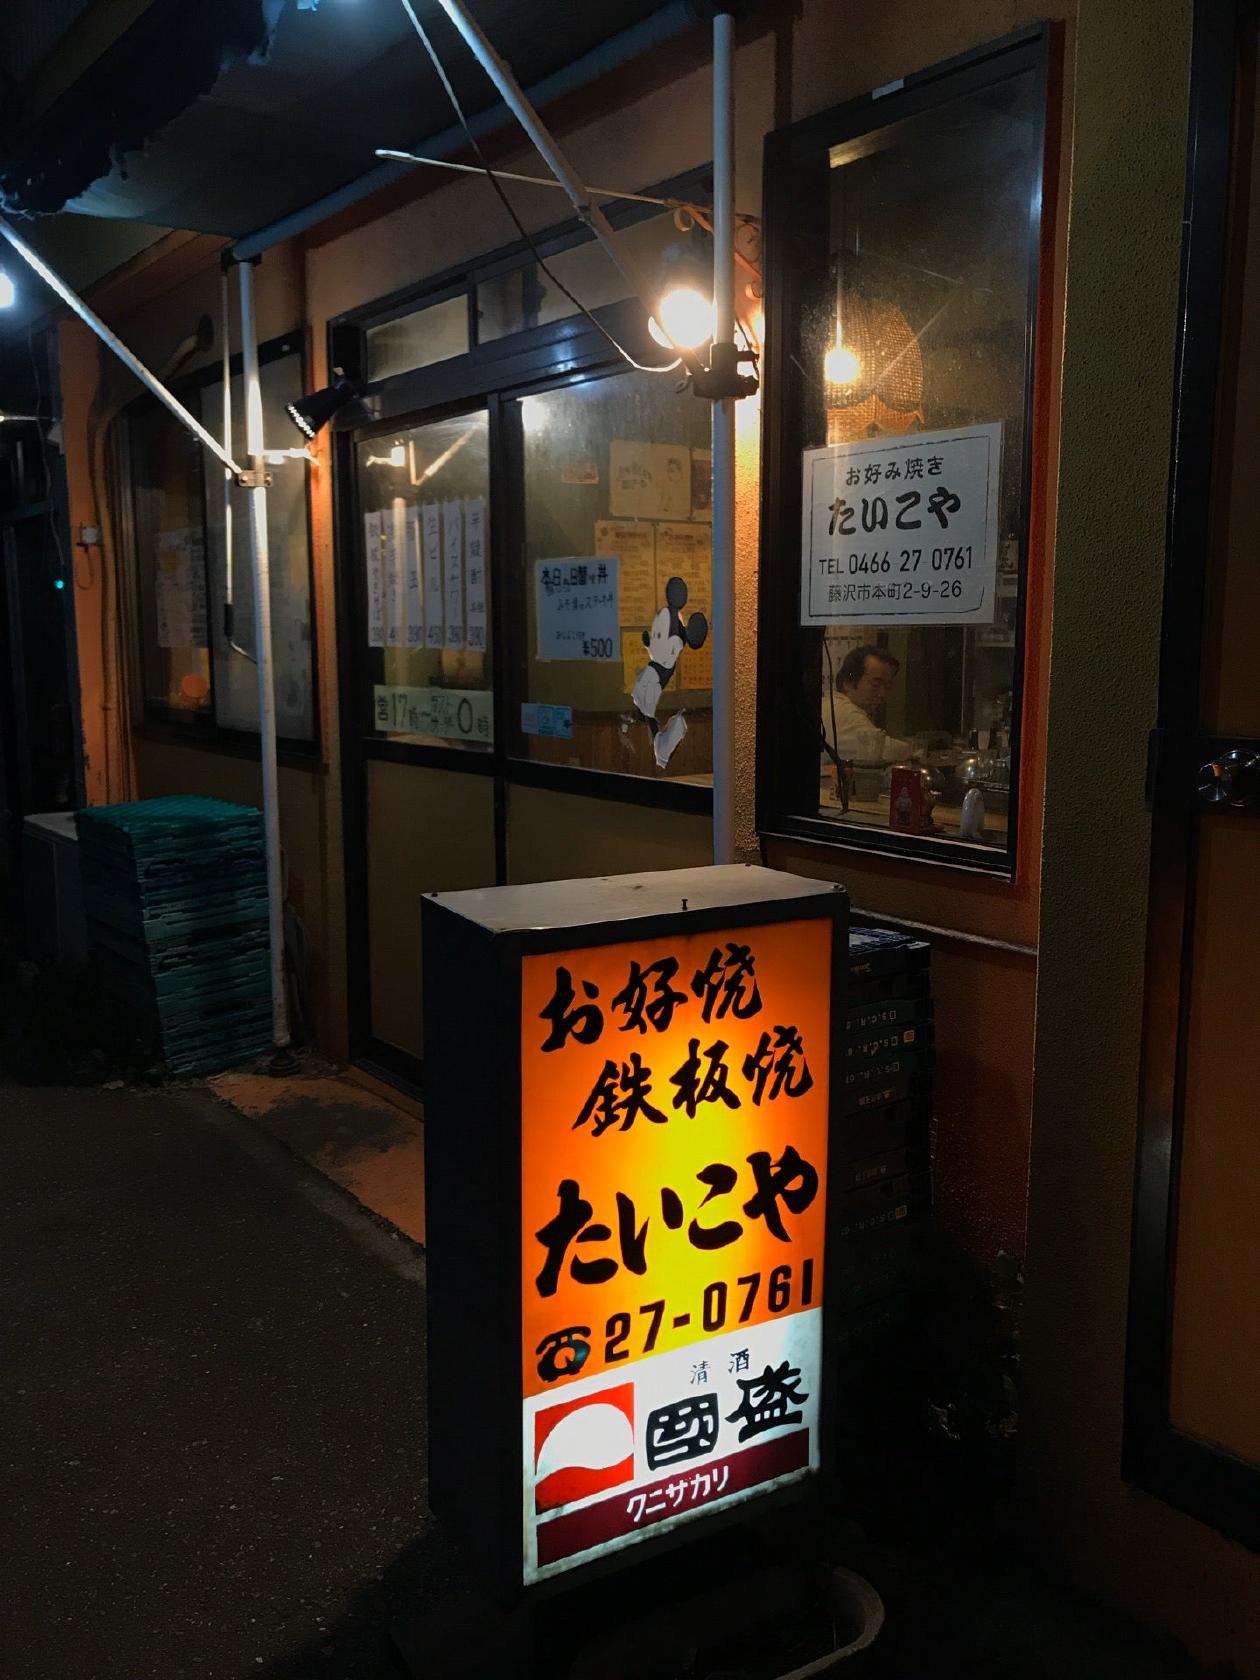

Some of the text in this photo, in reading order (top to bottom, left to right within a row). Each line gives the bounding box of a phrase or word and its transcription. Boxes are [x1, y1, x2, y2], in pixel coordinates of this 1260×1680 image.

[846, 456, 944, 486] お好み焼き
[828, 487, 961, 536] たいこや
[819, 559, 845, 575] TEL
[849, 551, 891, 575] 0466
[899, 549, 922, 572] 27
[931, 546, 973, 571] 0761
[828, 580, 963, 603] 藤沢市本町2-9-26
[582, 638, 613, 658] ¥500
[539, 943, 763, 1053] お好焼
[572, 1026, 814, 1137] 鉄板焼
[535, 1145, 819, 1298] たいこや
[605, 1259, 814, 1363] 27-0761
[690, 1348, 750, 1385] 清酒
